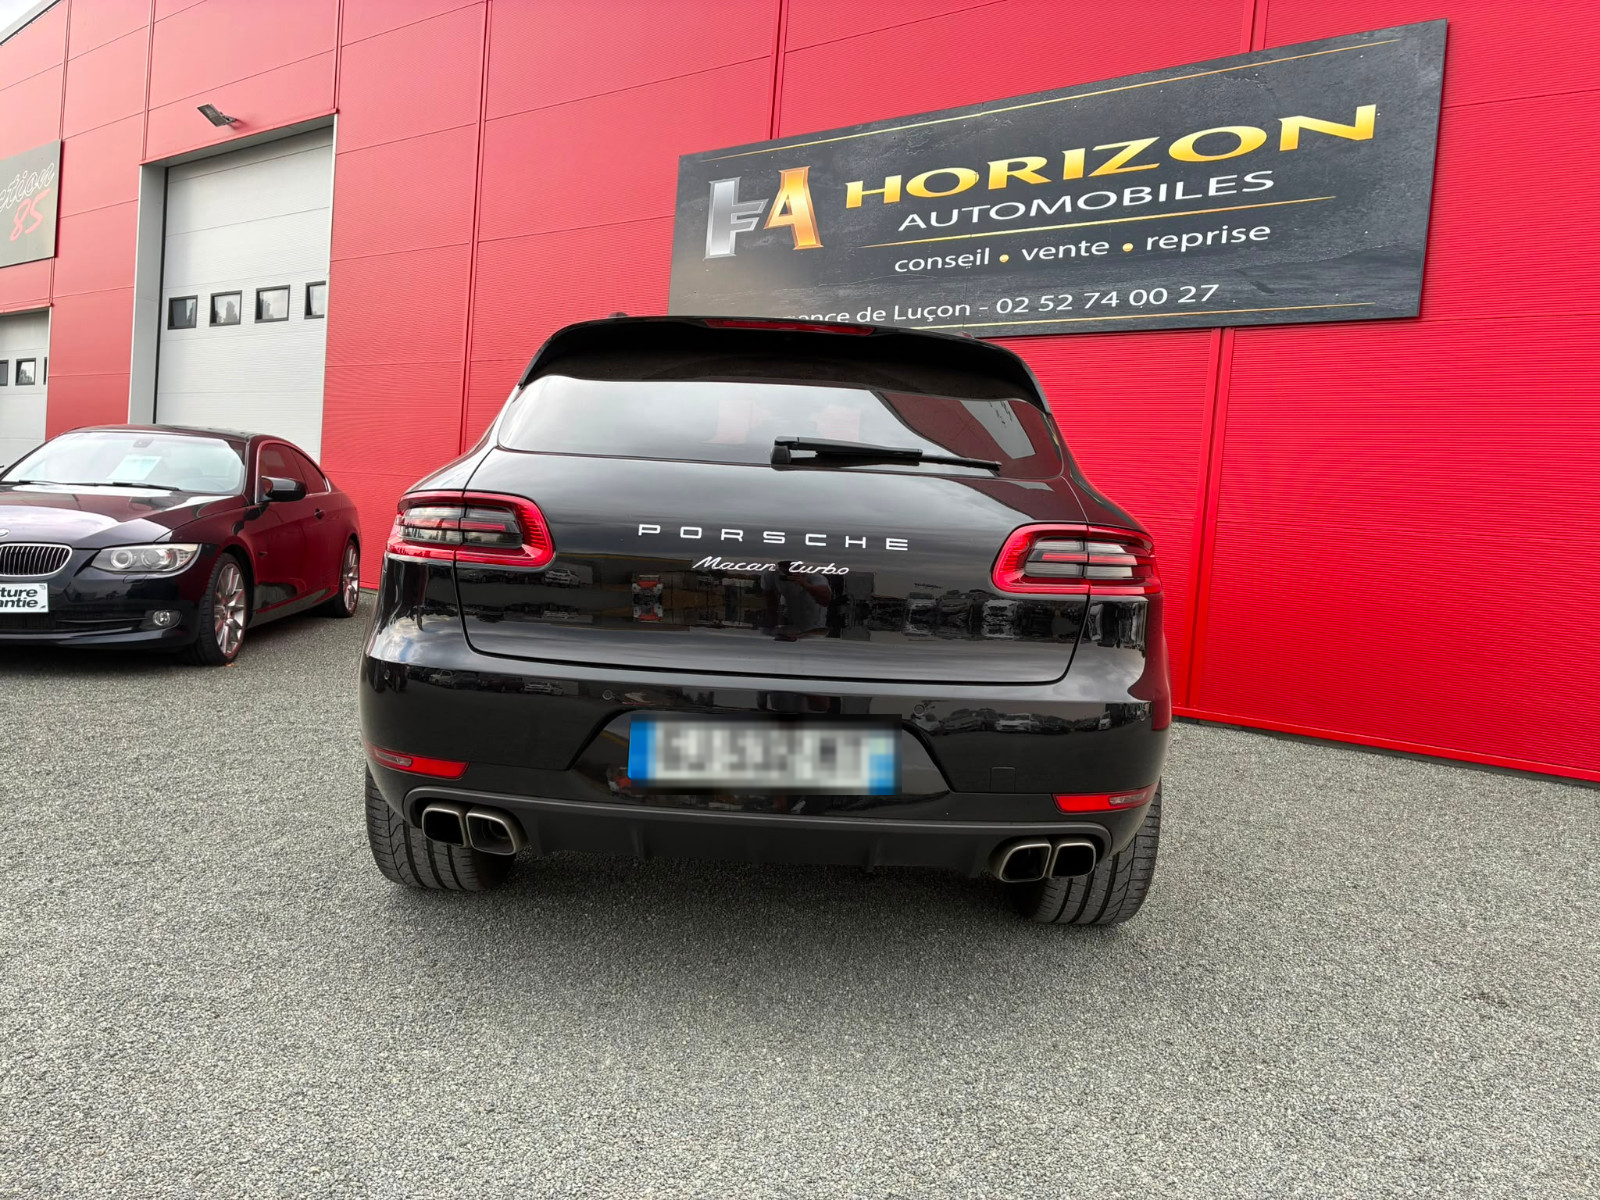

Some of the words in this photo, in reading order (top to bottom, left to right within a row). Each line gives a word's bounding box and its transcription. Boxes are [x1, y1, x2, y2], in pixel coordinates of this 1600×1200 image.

[845, 103, 1377, 209] HORIZON
[9, 187, 52, 242] 85
[897, 170, 1275, 232] AUTOMOBILES
[894, 247, 990, 272] conseil
[1021, 238, 1110, 261] vente
[1146, 224, 1271, 252] reprise
[856, 306, 887, 323] de
[894, 304, 971, 322] Luçon
[996, 297, 1030, 314] 02
[1038, 294, 1074, 312] 52
[1083, 291, 1120, 309] 74
[1128, 287, 1168, 306] 00
[1177, 284, 1220, 303] 27
[638, 523, 909, 552] PORSCHE
[692, 555, 777, 572] Macan
[788, 560, 850, 575] turbo
